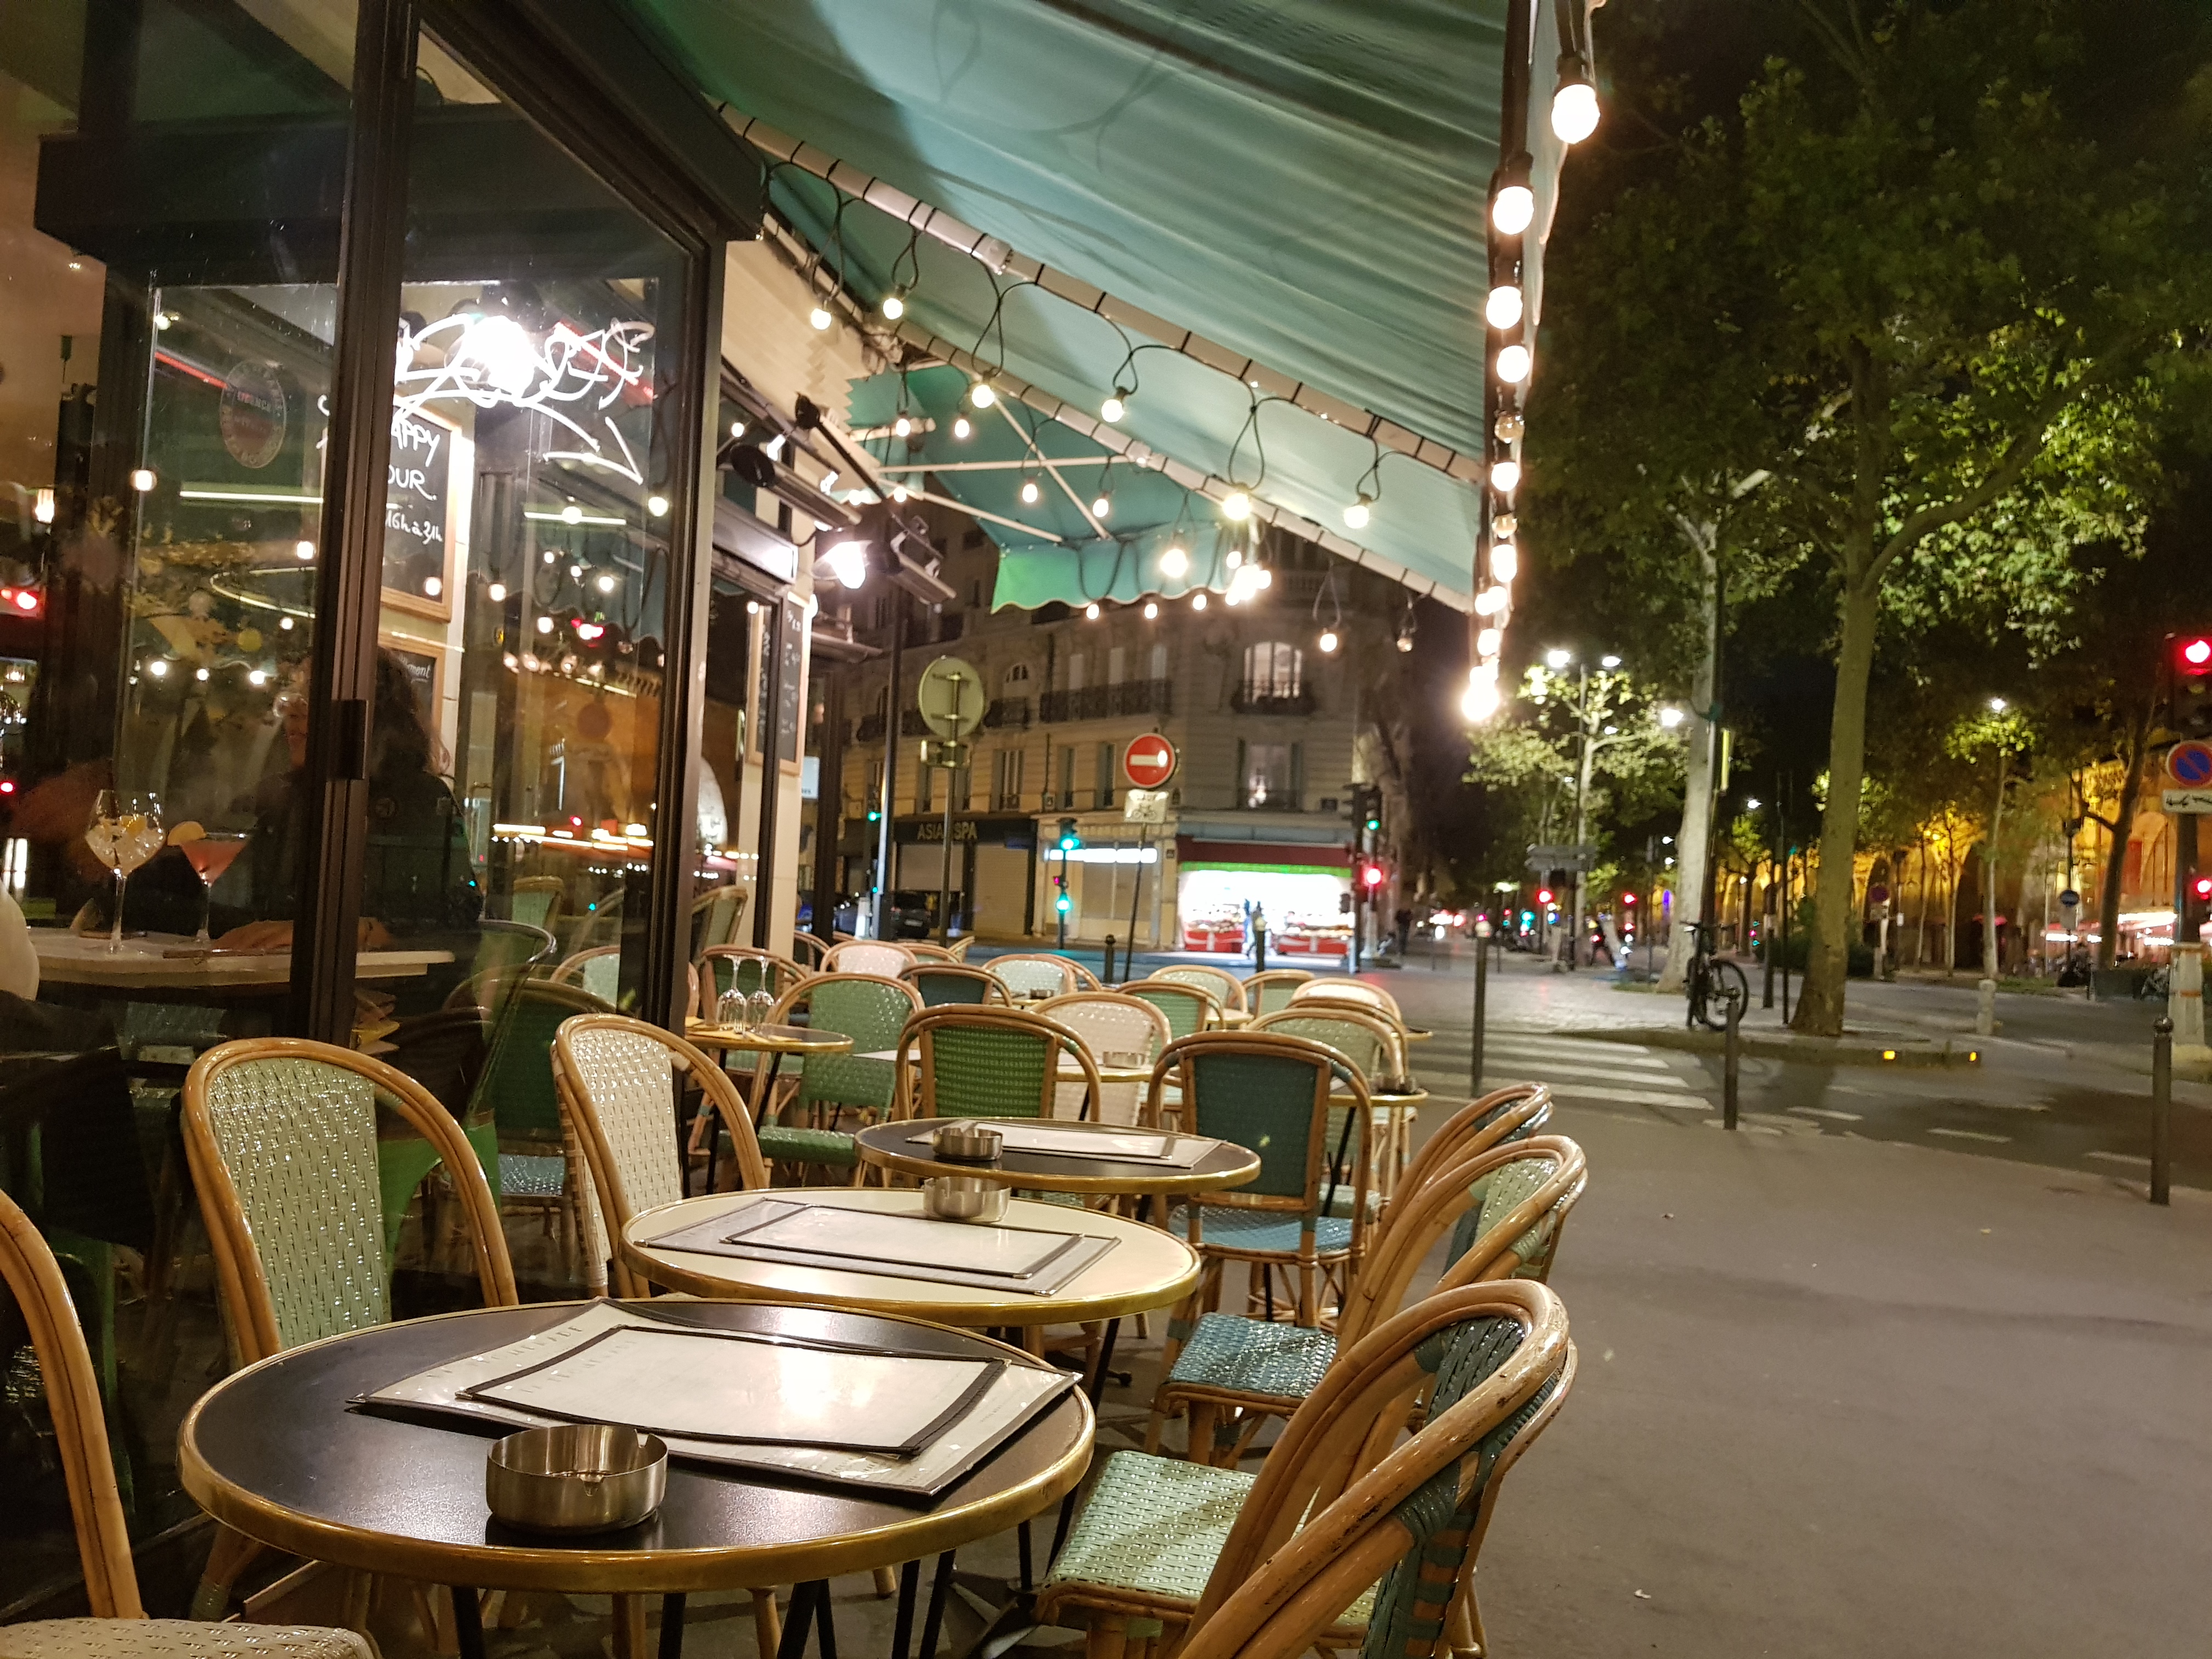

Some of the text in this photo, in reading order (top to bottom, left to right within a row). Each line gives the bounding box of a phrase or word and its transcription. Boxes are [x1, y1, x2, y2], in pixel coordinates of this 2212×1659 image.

[391, 417, 441, 467] APPY
[388, 464, 438, 501] OUR
[917, 821, 978, 840] ASIA SPA
